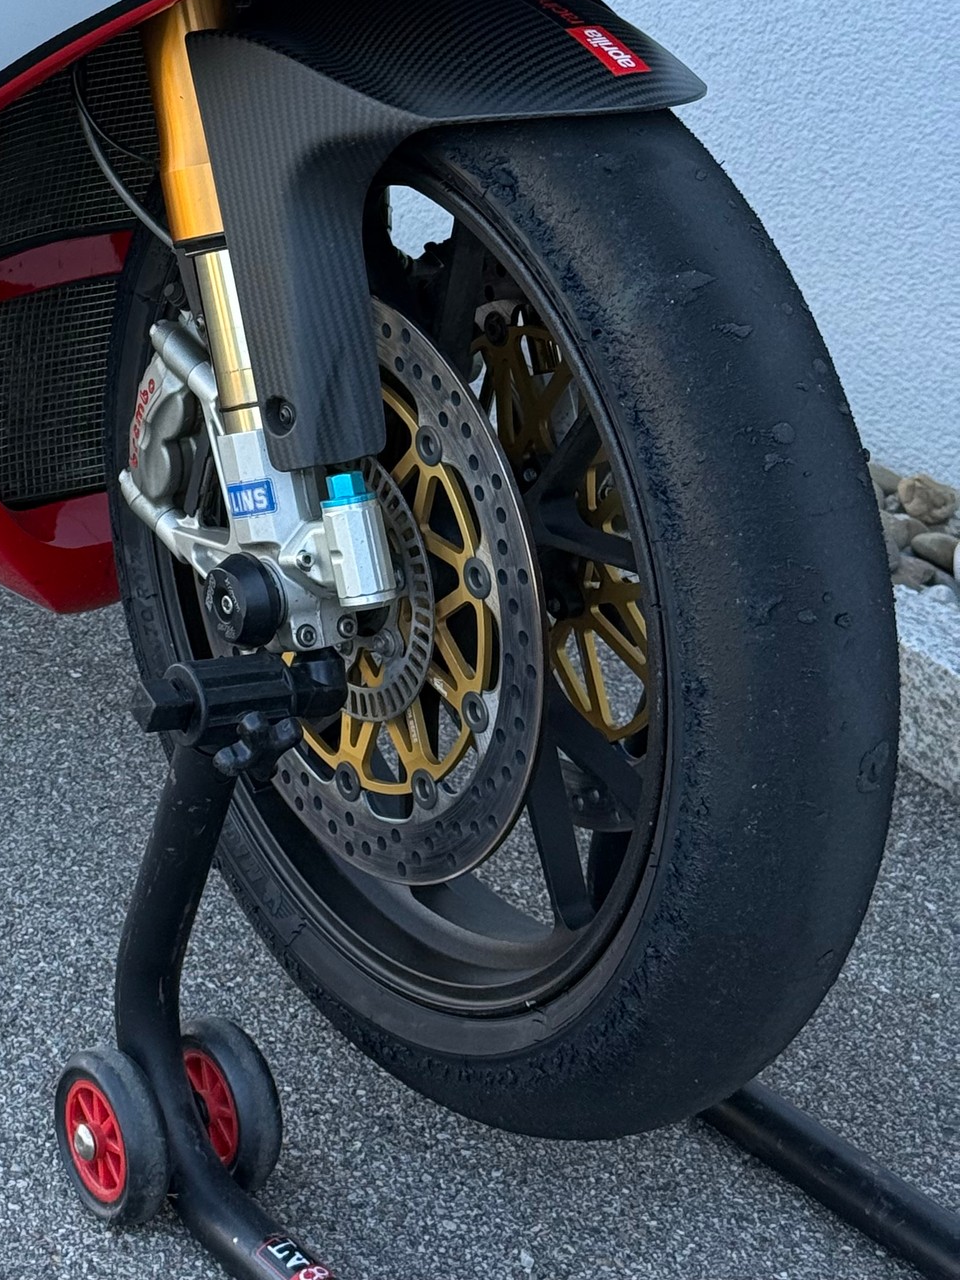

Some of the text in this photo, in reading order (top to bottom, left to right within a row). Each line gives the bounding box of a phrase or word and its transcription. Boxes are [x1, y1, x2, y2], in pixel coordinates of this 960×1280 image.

[583, 28, 637, 68] aprilia
[129, 378, 155, 469] brembo
[230, 486, 268, 514] LINS
